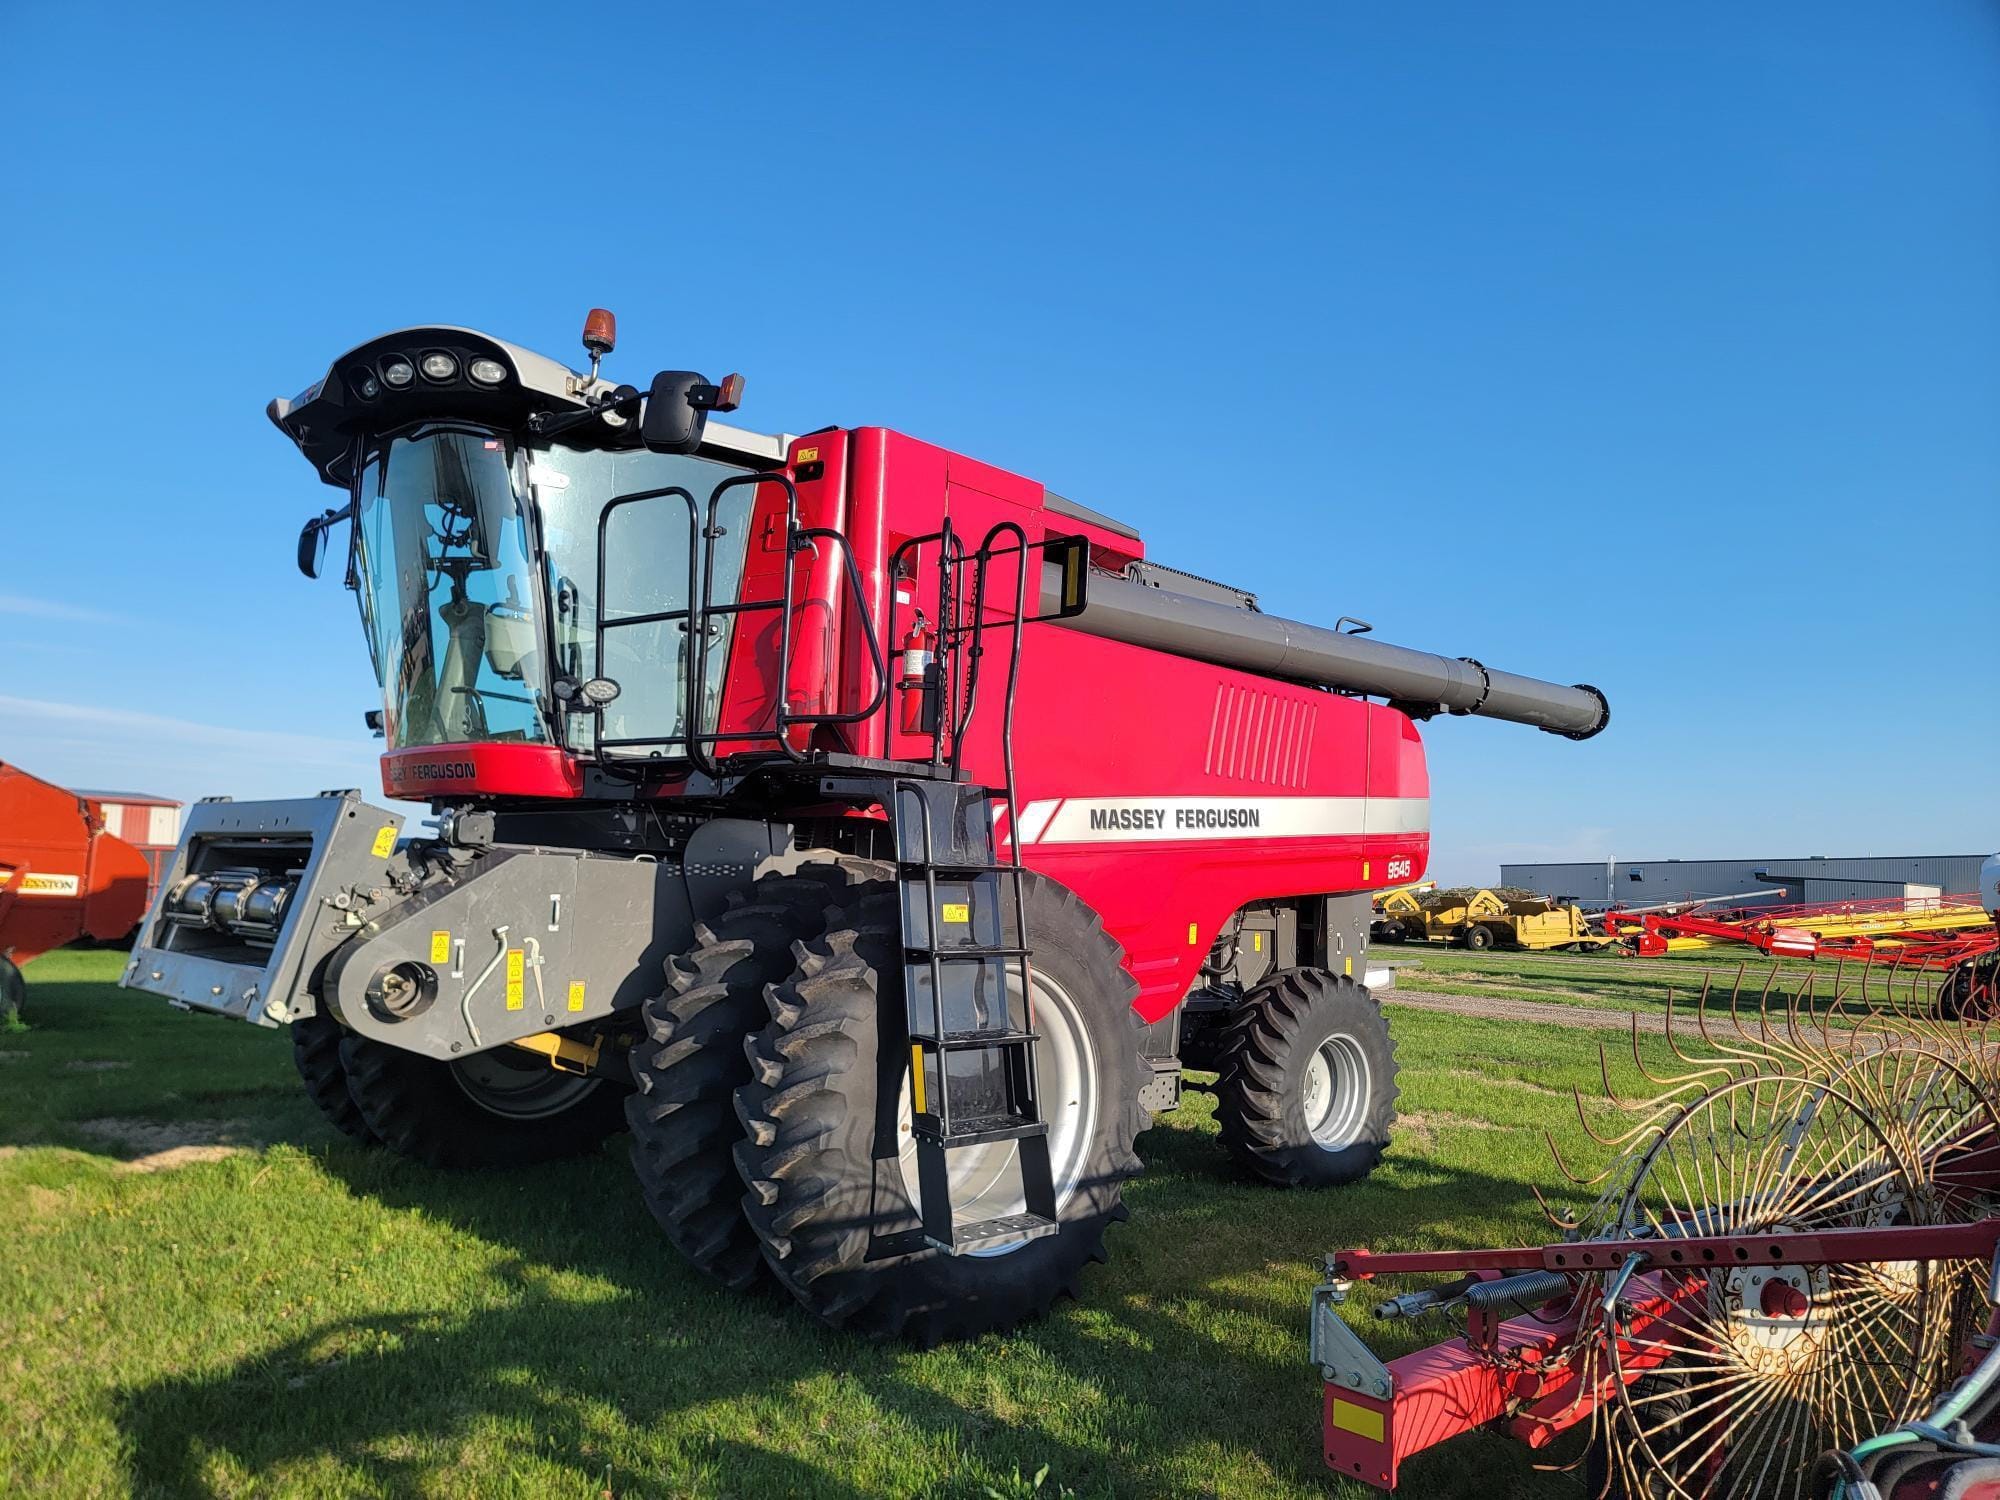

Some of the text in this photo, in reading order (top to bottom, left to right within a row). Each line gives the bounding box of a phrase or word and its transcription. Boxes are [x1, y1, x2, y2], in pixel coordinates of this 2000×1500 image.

[412, 763, 476, 779] FERGUSON
[1090, 808, 1260, 830] MASSEY FERGUSON
[1387, 860, 1411, 880] 9545
[23, 878, 74, 889] ESSTON
